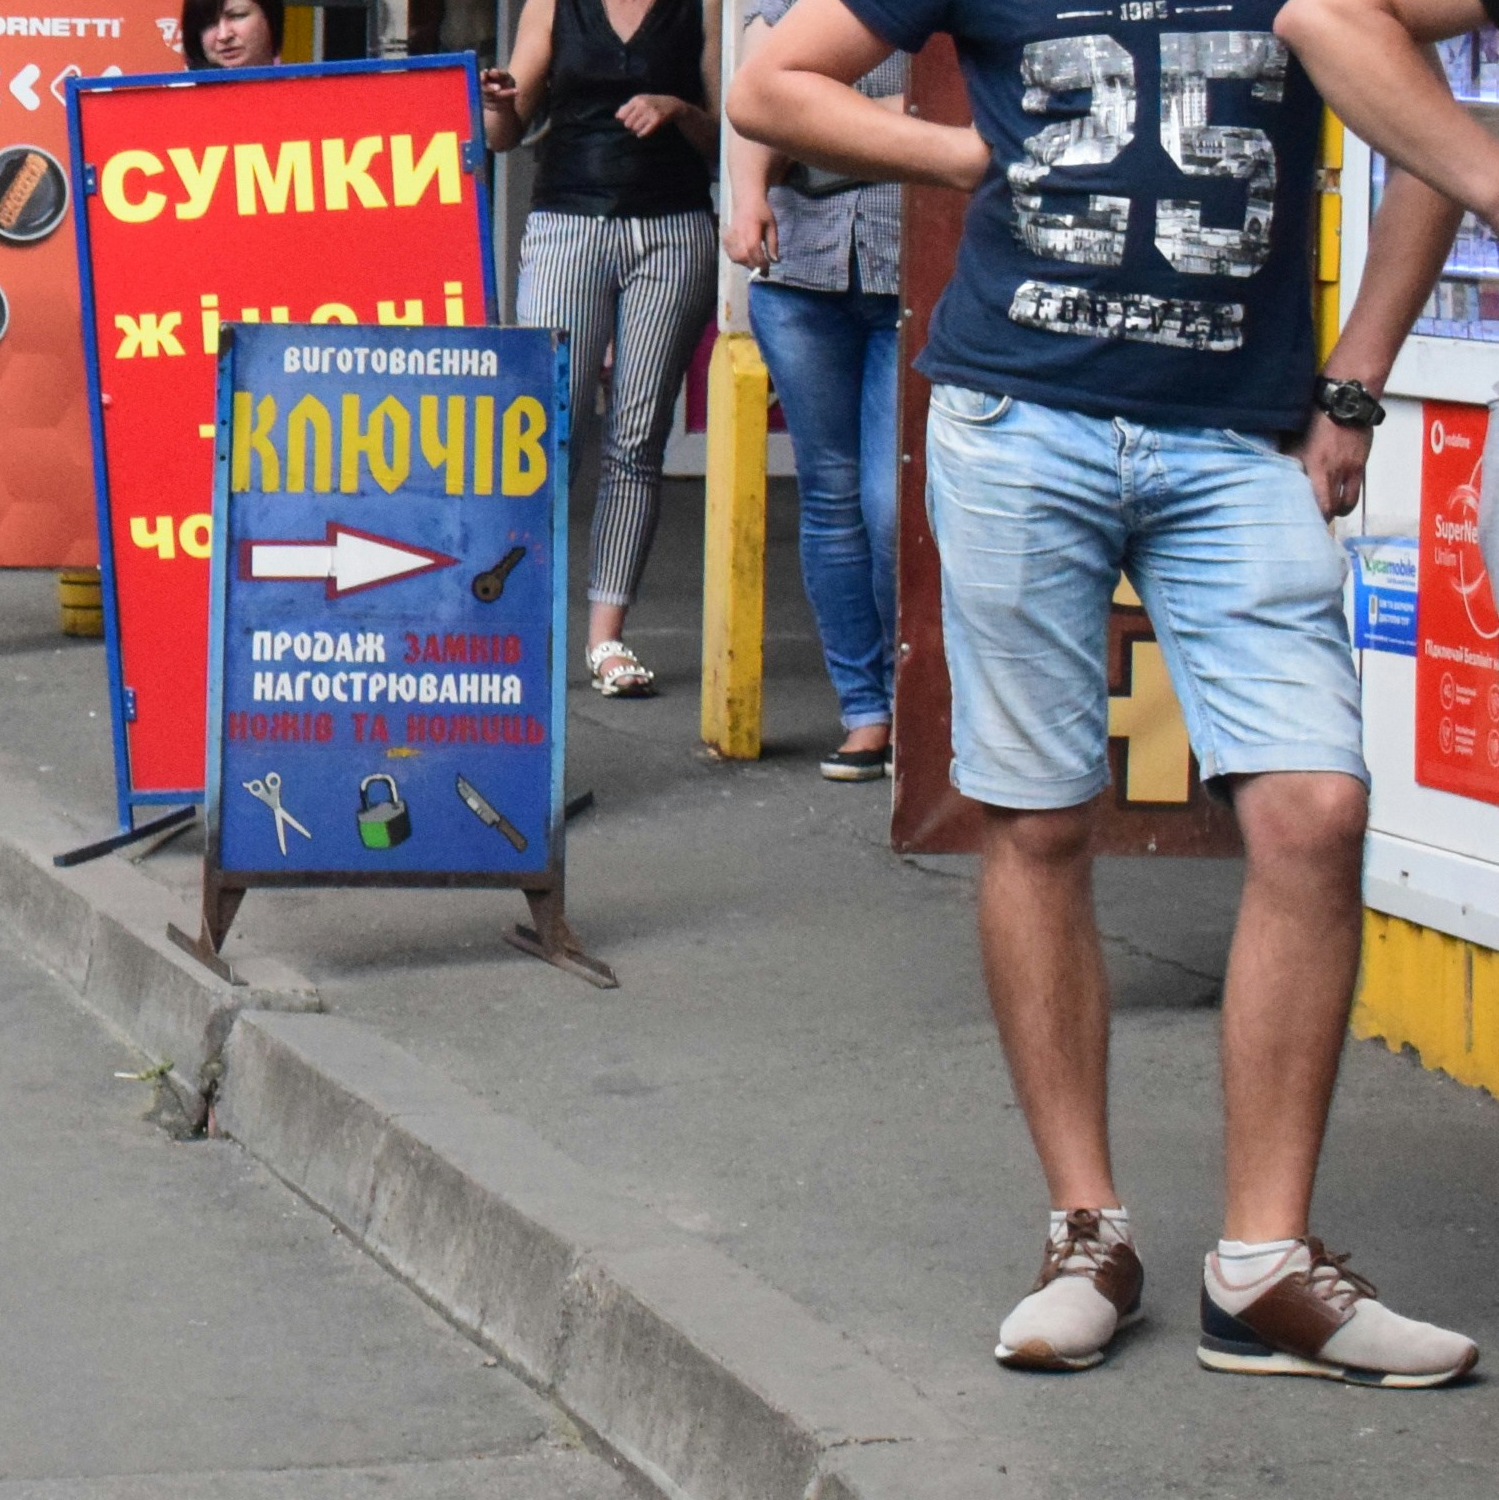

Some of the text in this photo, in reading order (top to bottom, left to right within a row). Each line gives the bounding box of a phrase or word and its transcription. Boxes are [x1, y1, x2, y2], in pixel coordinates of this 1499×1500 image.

[100, 130, 463, 224] СУМКИ
[283, 346, 498, 377] ВИГОТОВЛЕННЯ
[232, 392, 548, 496] КЛЮЧІВ
[252, 630, 522, 664] ПРОДАЖ ЗАМКІВ
[253, 671, 521, 705] НАГОСТРЮВАННЯ
[229, 710, 545, 746] НОЖІВ ТА НОЖИЦЬ
